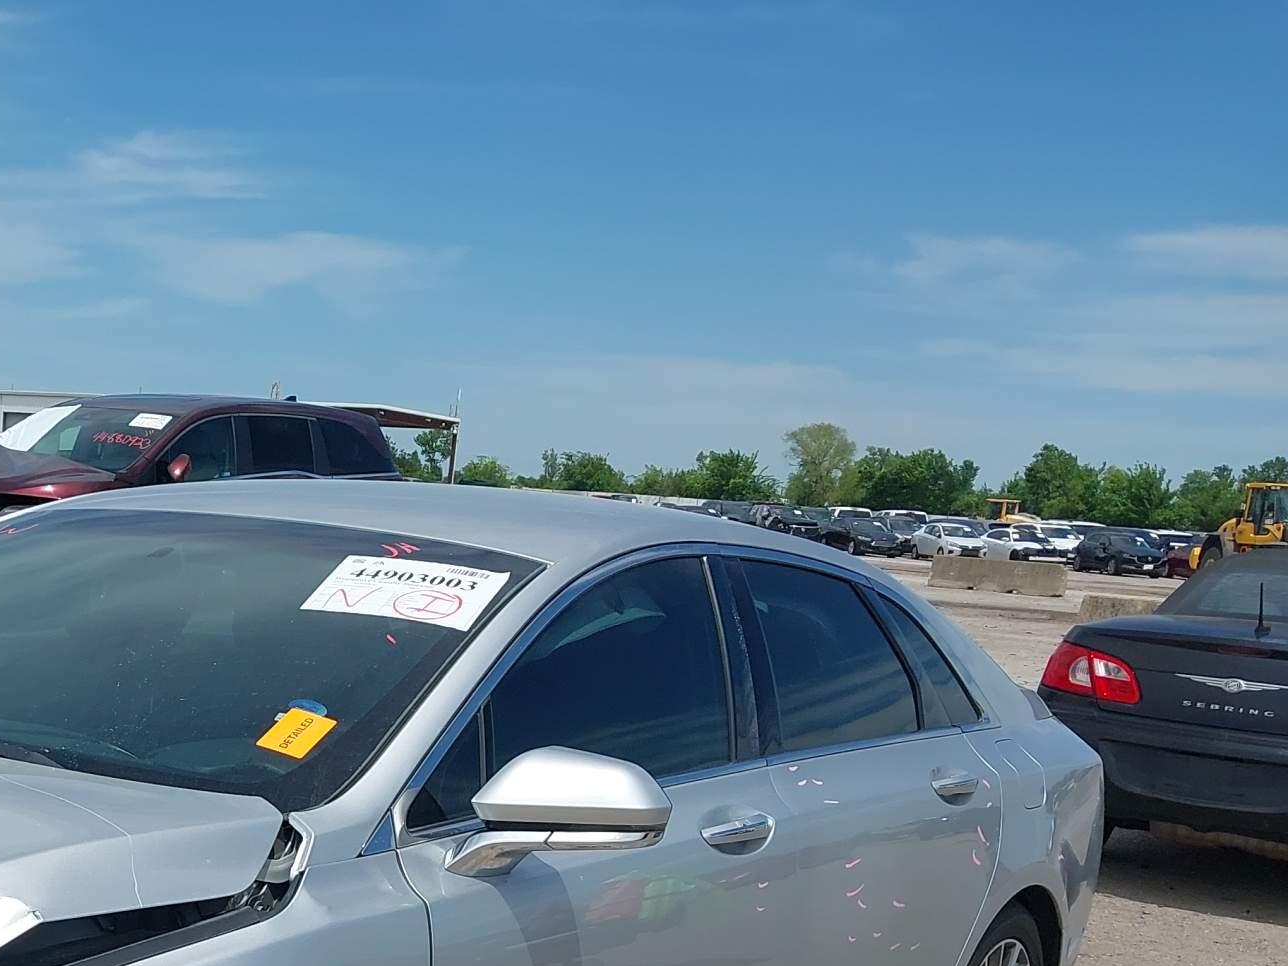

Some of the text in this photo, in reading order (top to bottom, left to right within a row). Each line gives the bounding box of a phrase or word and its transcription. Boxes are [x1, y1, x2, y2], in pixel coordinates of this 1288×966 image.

[349, 567, 480, 591] 44903003
[1182, 699, 1275, 717] SEBRING
[278, 717, 314, 749] DETAILED
